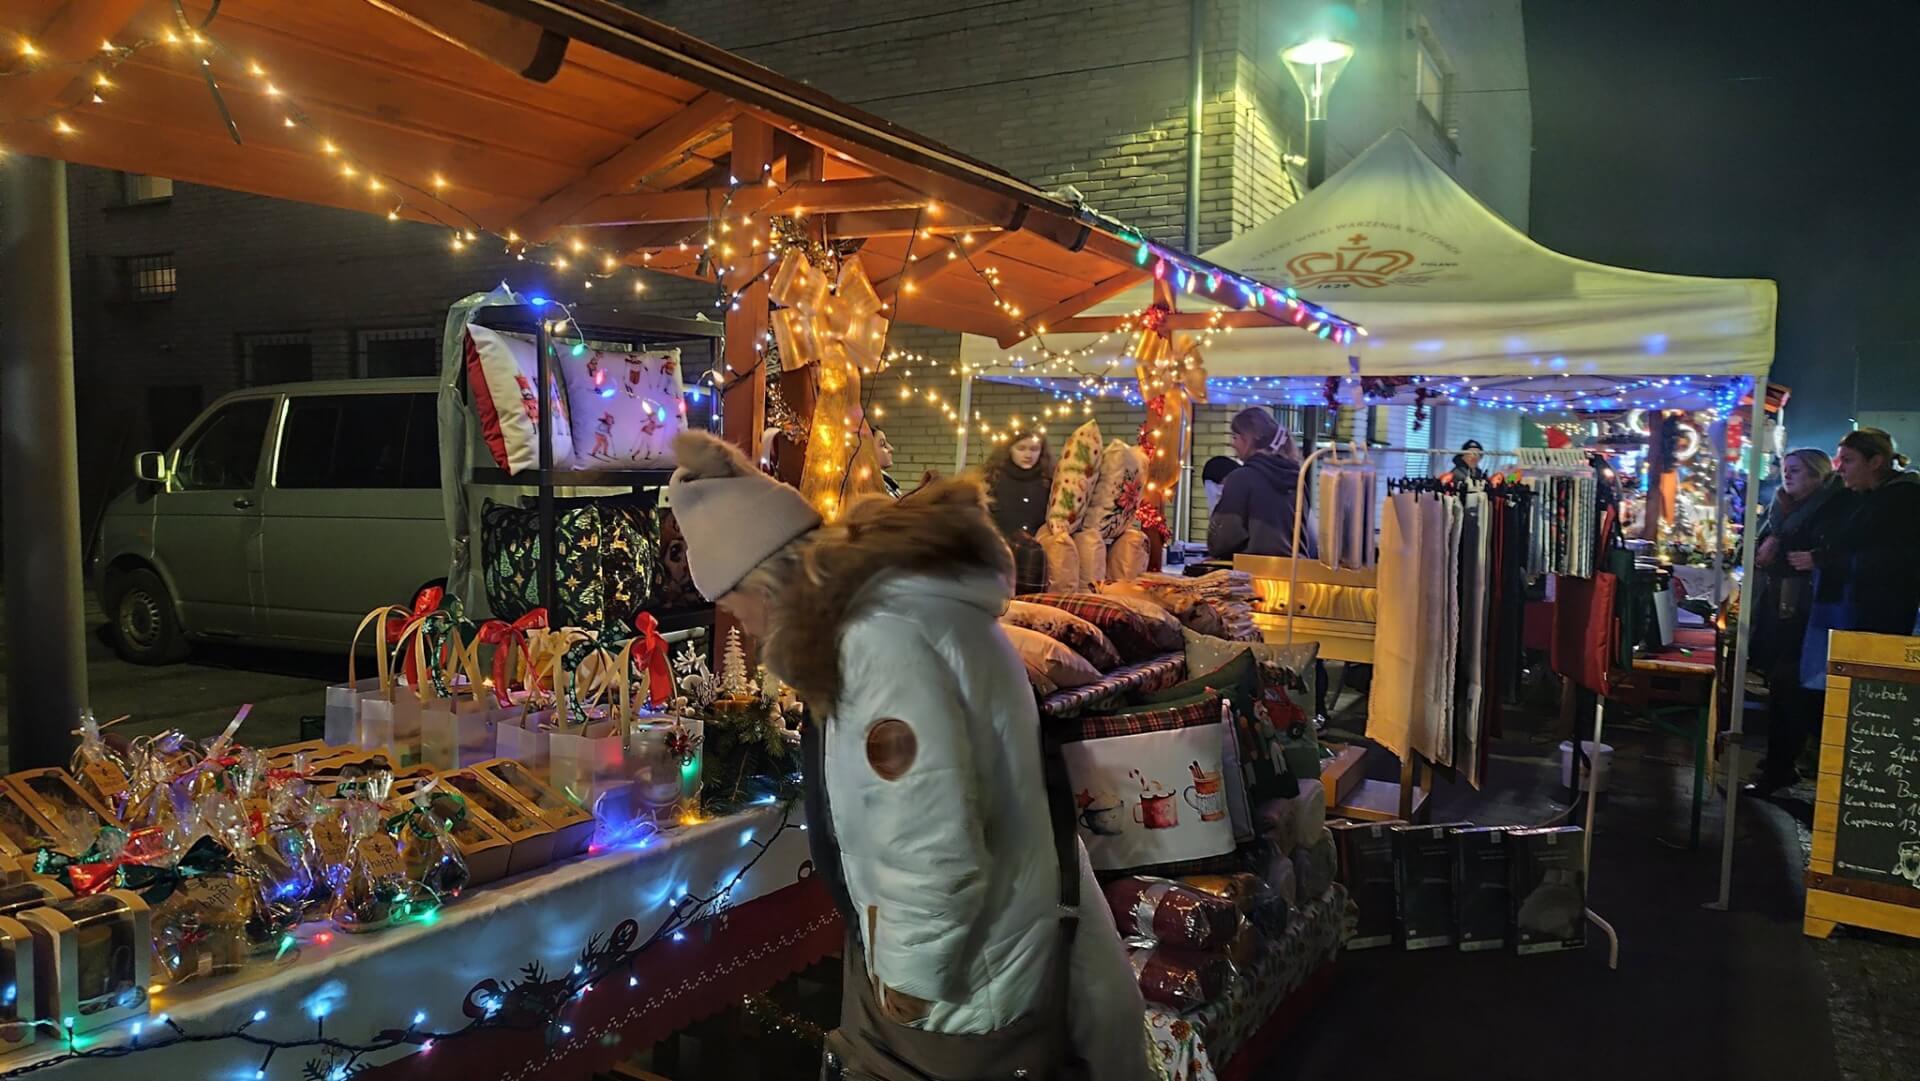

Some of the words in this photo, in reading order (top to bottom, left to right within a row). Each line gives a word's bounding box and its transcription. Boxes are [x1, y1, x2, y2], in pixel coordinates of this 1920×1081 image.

[1335, 220, 1401, 231] WARZENIA
[1858, 684, 1908, 701] Herbata
[195, 880, 234, 909] happy
